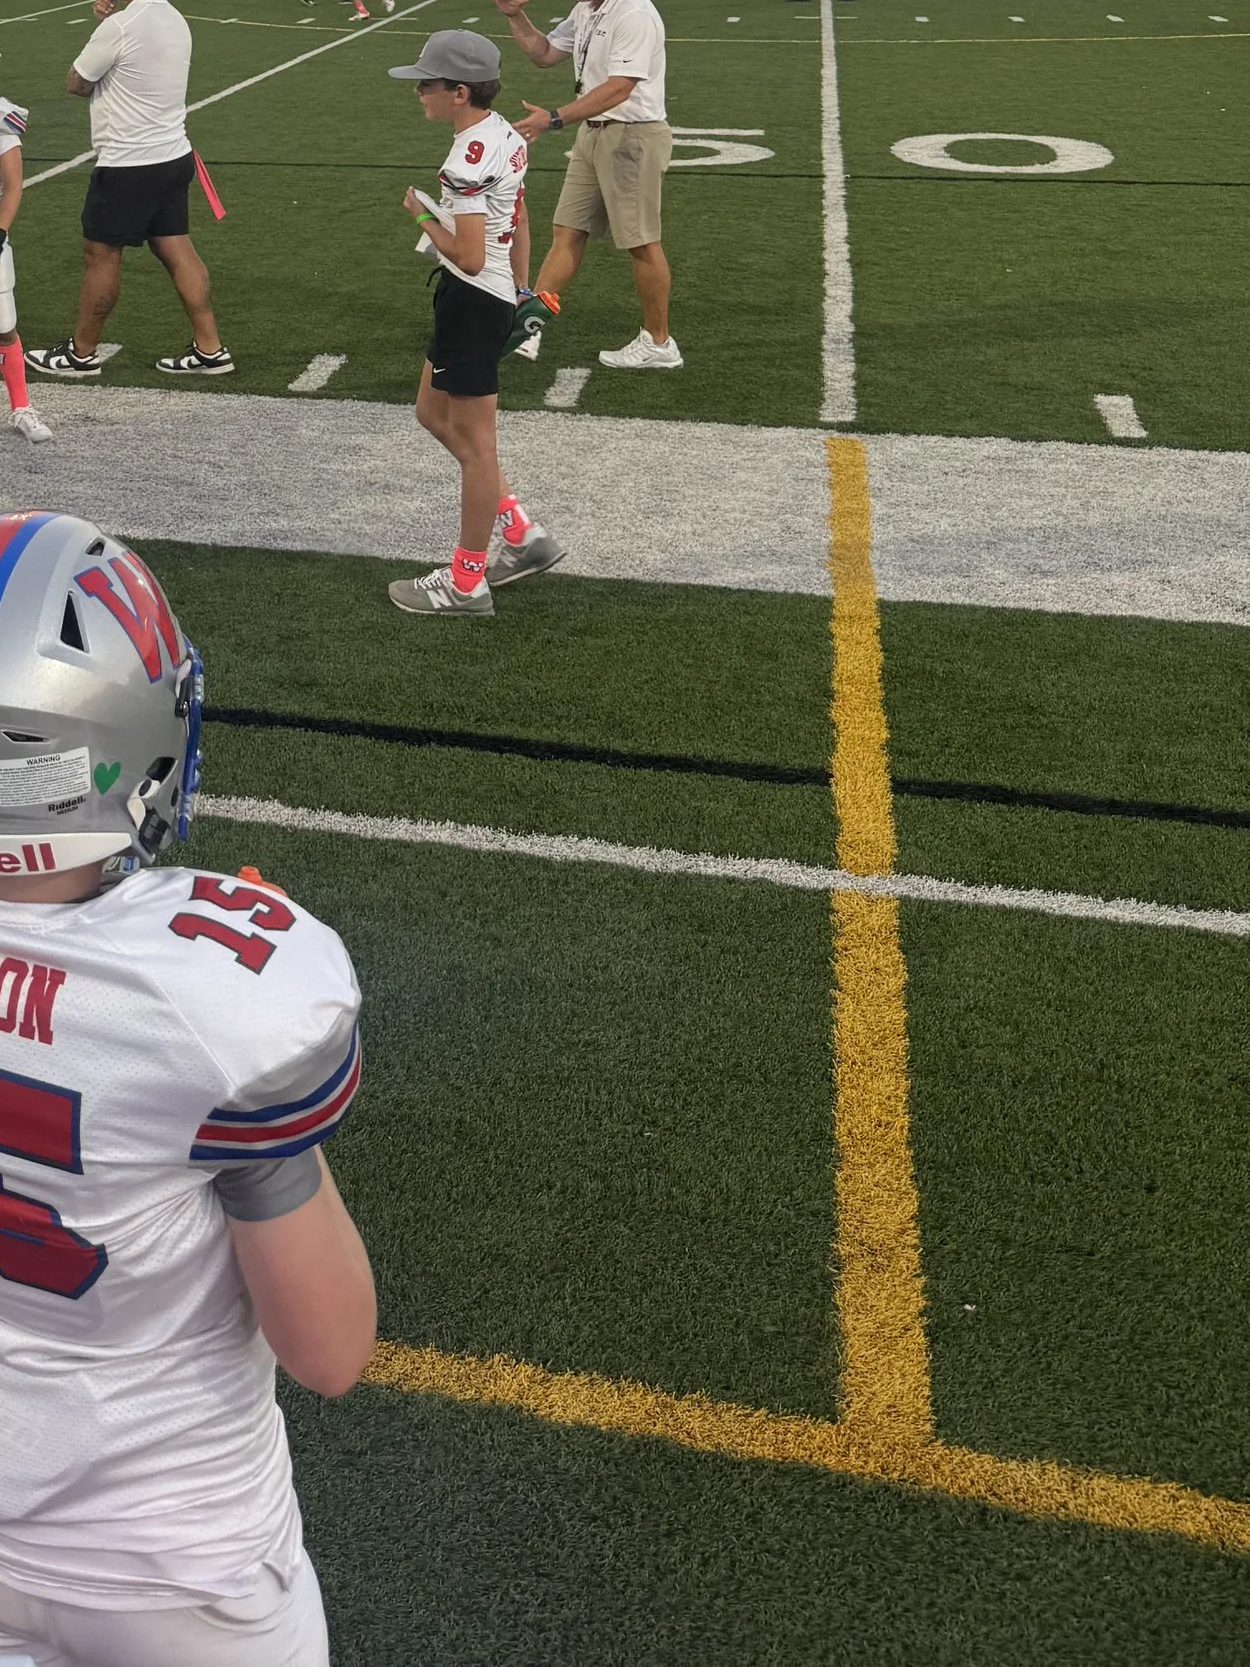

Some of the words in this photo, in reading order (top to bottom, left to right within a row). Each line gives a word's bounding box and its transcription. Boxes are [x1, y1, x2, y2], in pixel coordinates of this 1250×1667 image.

[464, 140, 485, 165] 9
[426, 589, 453, 609] N
[73, 549, 181, 684] W
[26, 754, 61, 766] WARNING
[167, 875, 297, 976] 15
